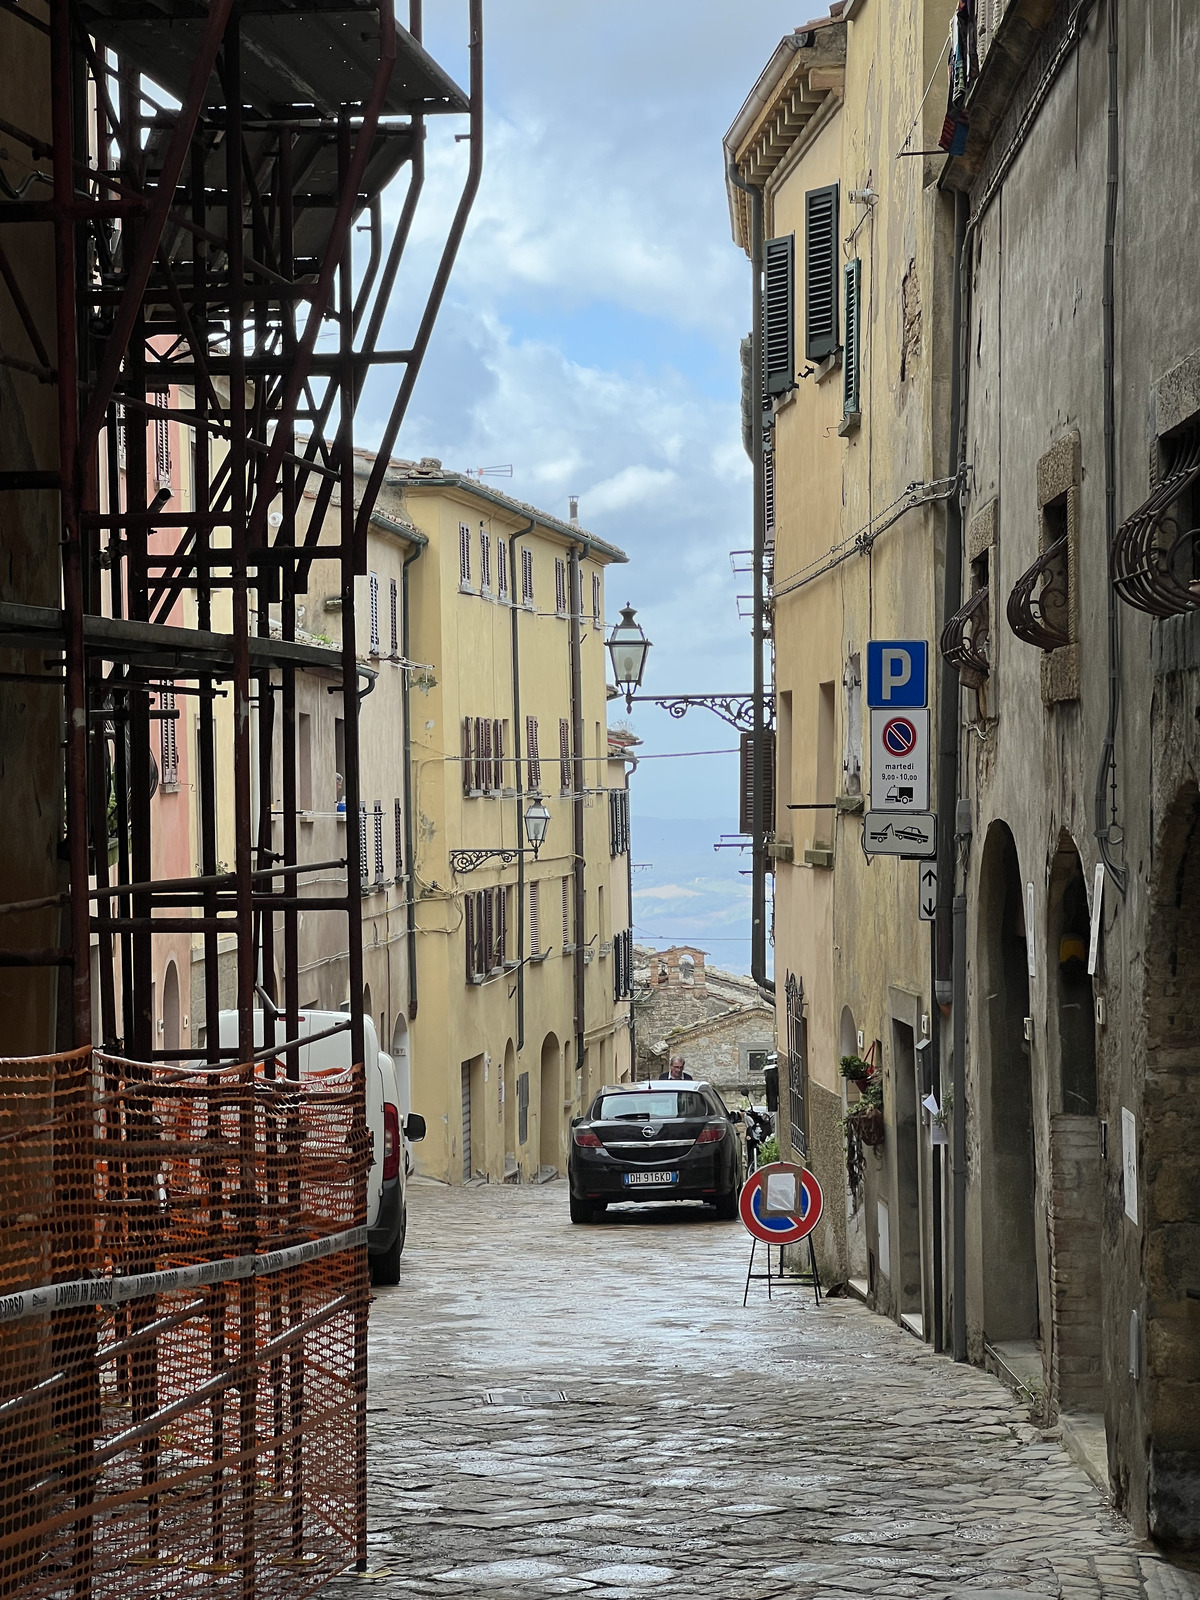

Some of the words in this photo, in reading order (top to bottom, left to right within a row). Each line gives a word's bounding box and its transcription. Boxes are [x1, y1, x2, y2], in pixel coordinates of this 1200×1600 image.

[881, 648, 912, 700] P
[55, 1284, 79, 1306] LAVORI
[80, 1283, 88, 1301] IN
[90, 1281, 113, 1300] CORSO
